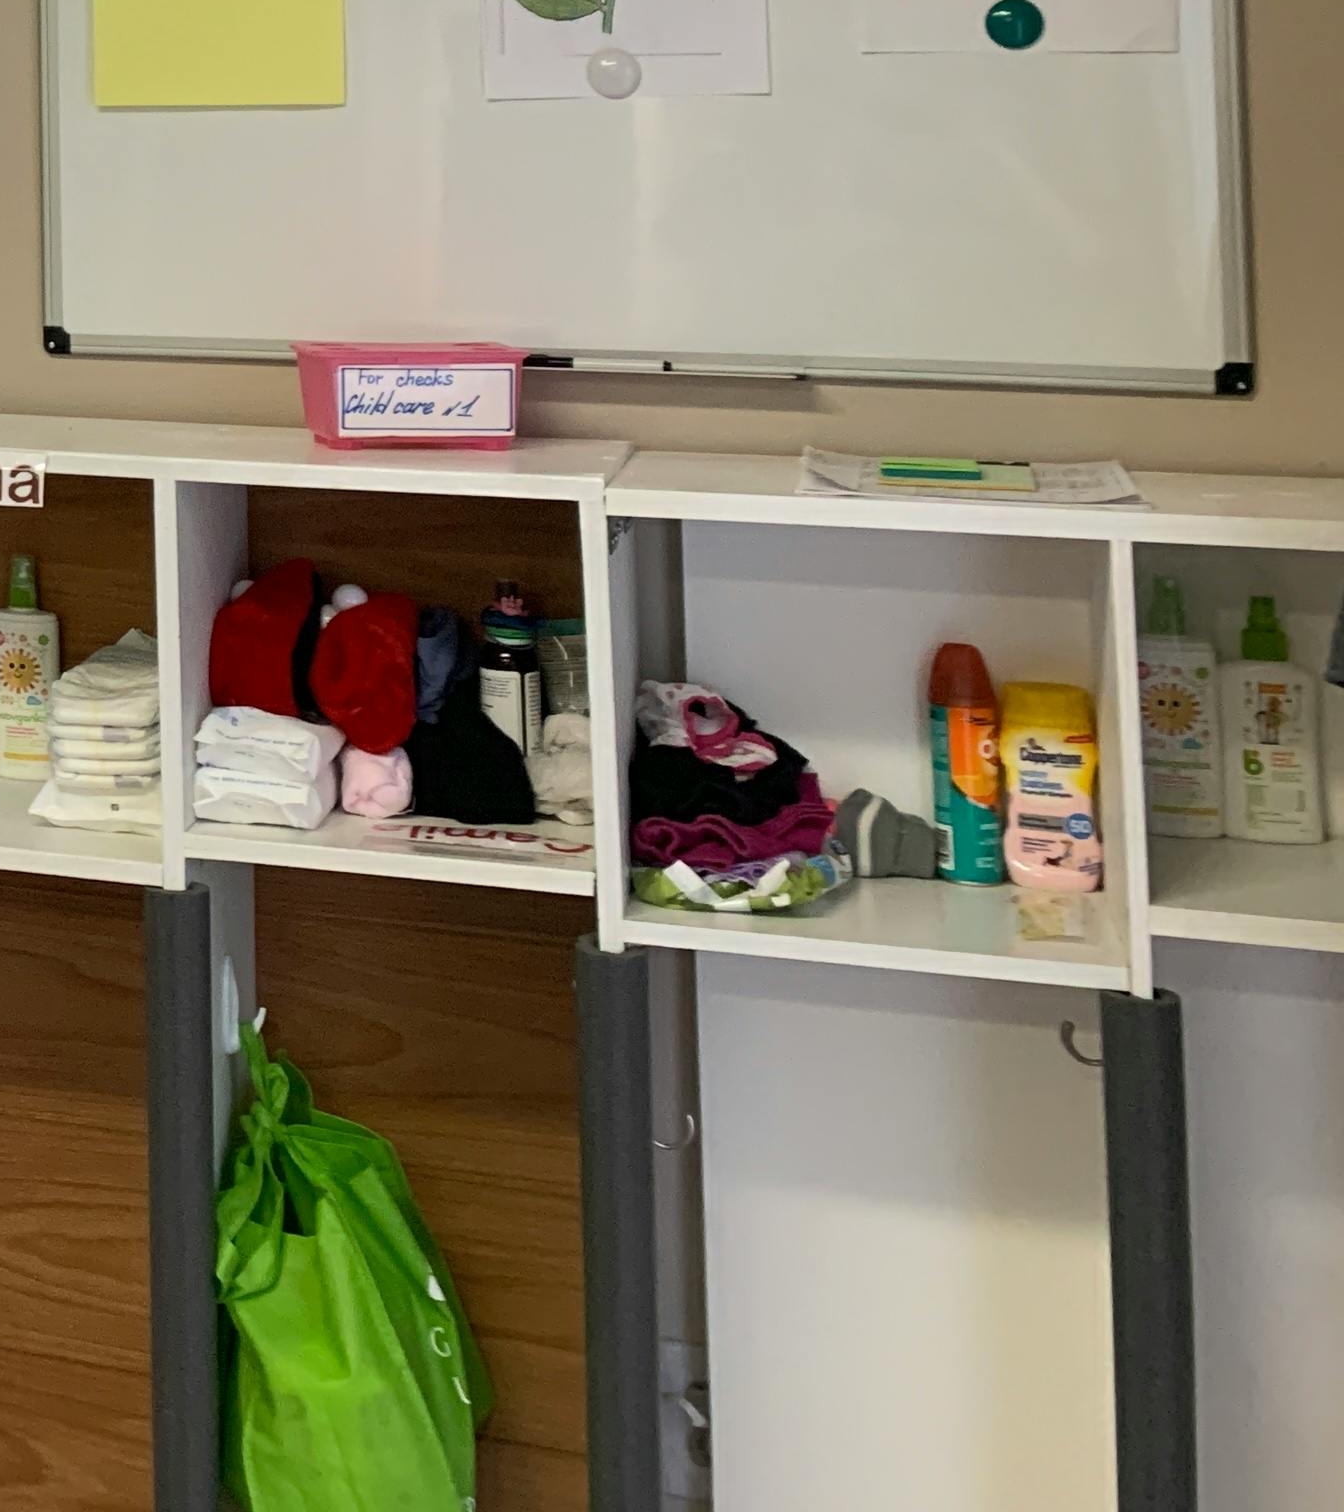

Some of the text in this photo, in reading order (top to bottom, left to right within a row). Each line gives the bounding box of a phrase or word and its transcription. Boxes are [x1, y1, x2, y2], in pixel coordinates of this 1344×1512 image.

[358, 368, 454, 387] For checks
[344, 390, 395, 416] Child
[393, 400, 435, 415] care
